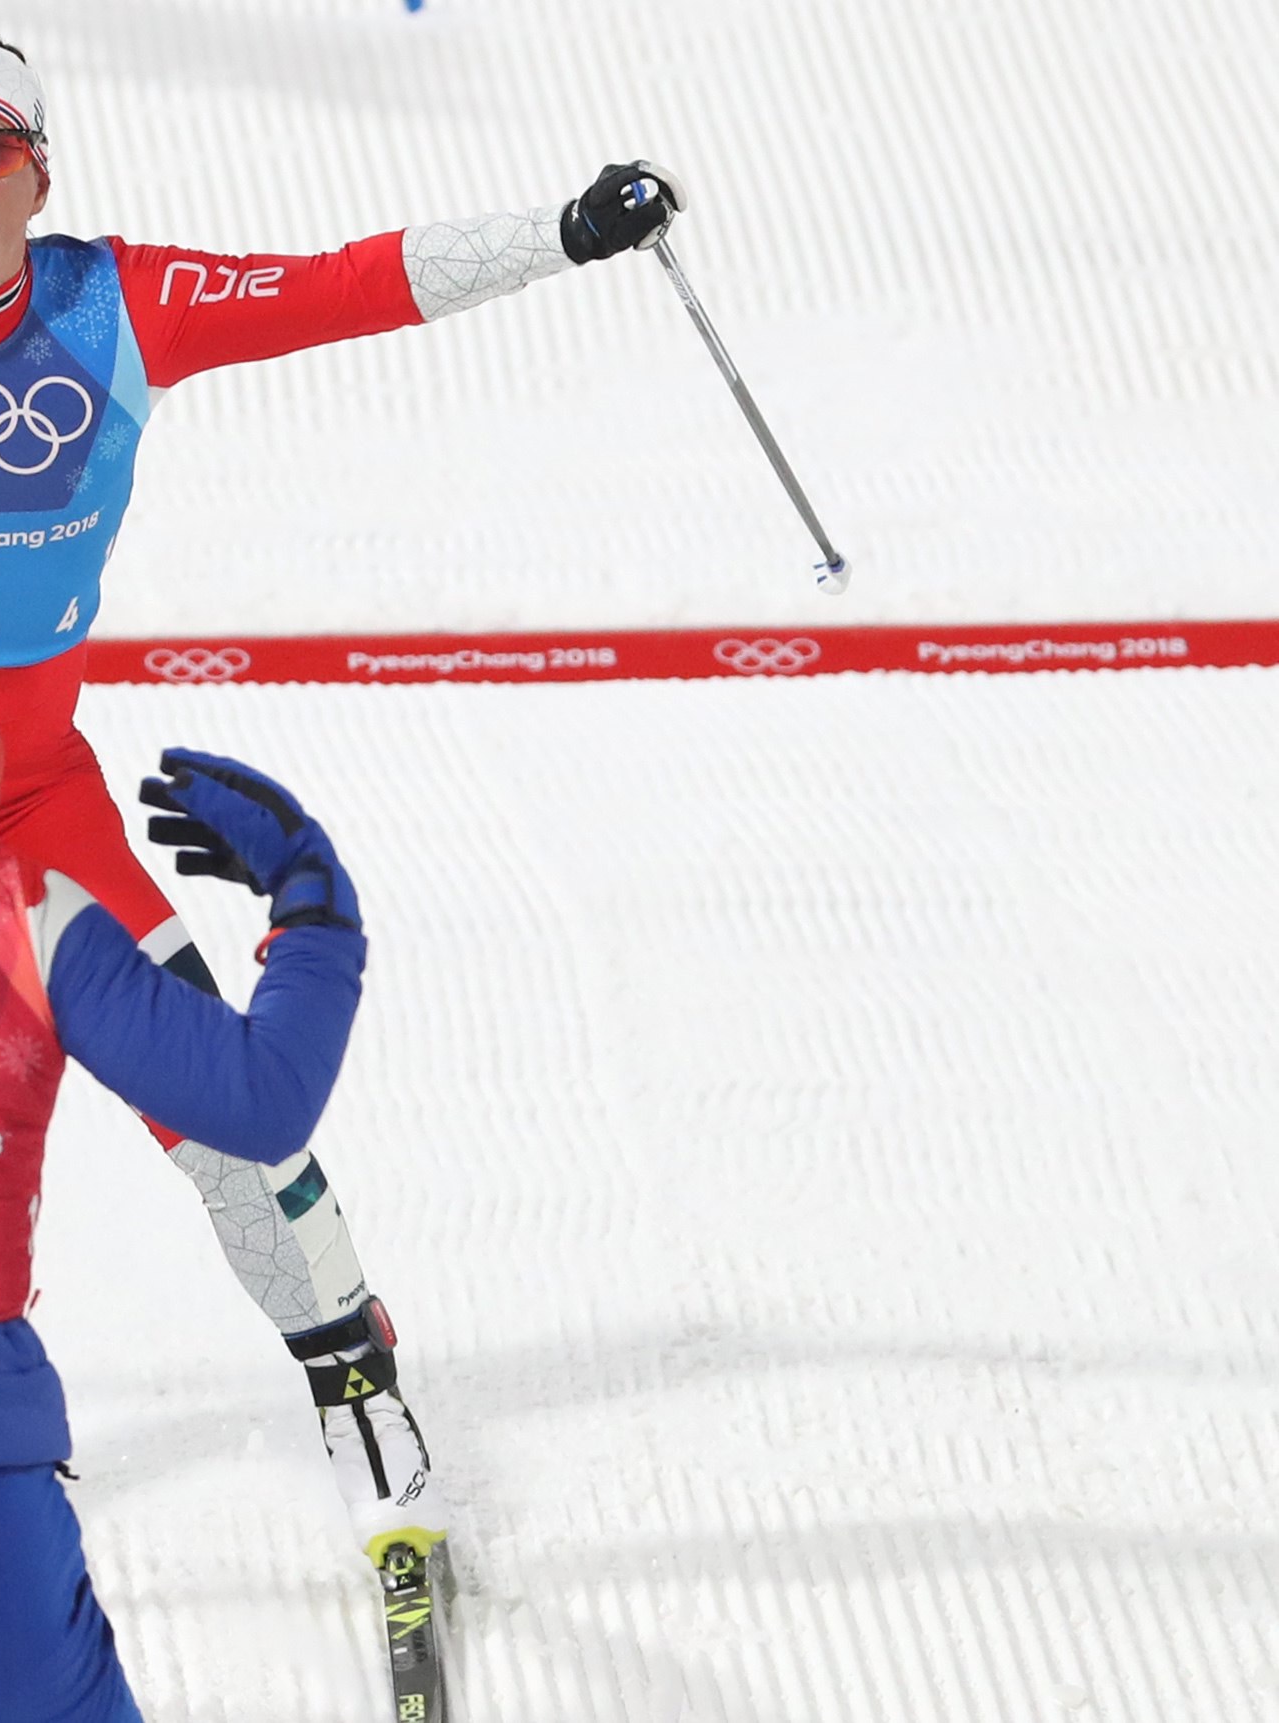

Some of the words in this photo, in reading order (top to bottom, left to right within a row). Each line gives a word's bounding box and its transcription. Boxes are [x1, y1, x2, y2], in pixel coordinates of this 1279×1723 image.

[49, 511, 99, 542] 2018
[55, 597, 79, 634] 4
[347, 650, 545, 674] PyeongChang
[548, 647, 617, 668] 2018
[917, 639, 1117, 665] PyeongChang
[1120, 636, 1188, 657] 2018
[396, 1470, 426, 1508] FISC
